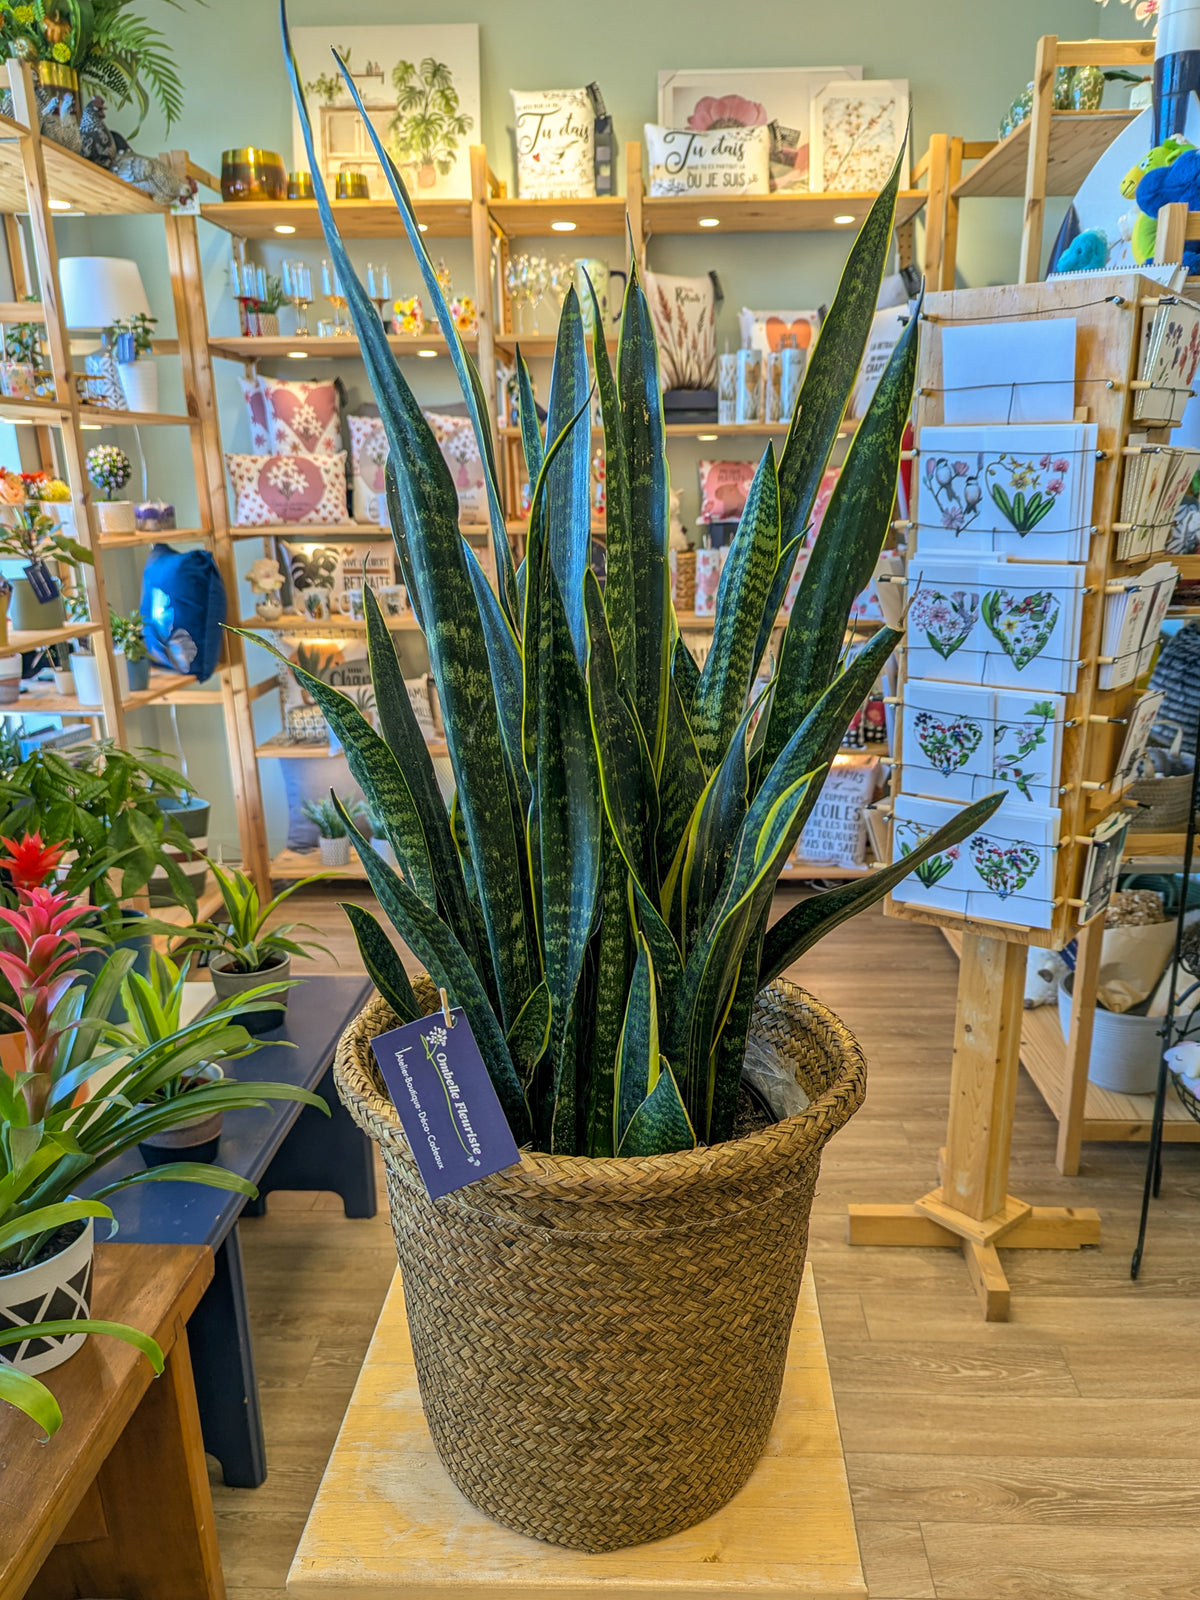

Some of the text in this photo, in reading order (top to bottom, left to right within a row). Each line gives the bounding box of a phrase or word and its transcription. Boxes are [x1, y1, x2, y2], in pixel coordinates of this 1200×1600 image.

[705, 172, 718, 188] JE
[723, 172, 746, 187] SUIS
[813, 802, 861, 822] TOILES
[436, 1052, 482, 1155] Ombelle Fleuriste
[427, 1134, 445, 1170] Cadeaux
